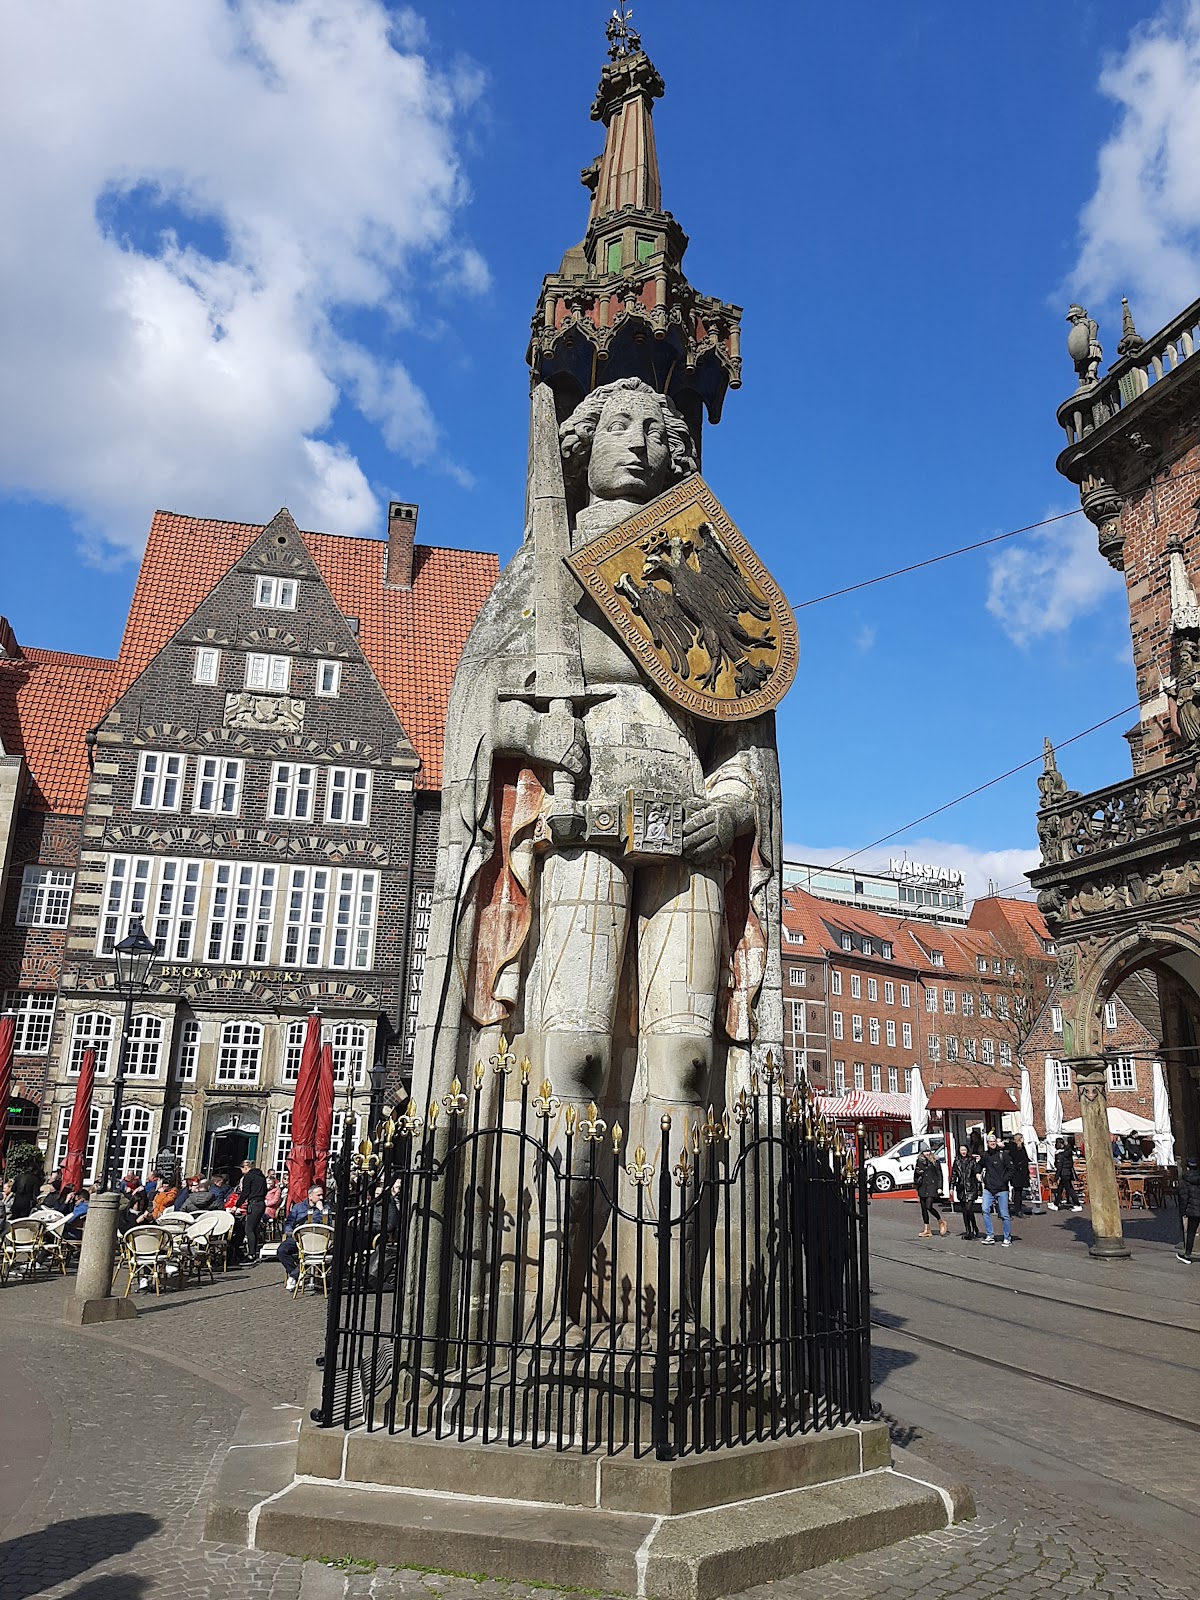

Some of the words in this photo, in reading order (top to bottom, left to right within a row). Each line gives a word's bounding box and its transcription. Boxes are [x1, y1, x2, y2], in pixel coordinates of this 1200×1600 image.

[889, 858, 966, 886] KARSTADT
[219, 969, 243, 980] AM
[249, 970, 305, 983] MARKT
[208, 1083, 264, 1092] RESTAURANT
